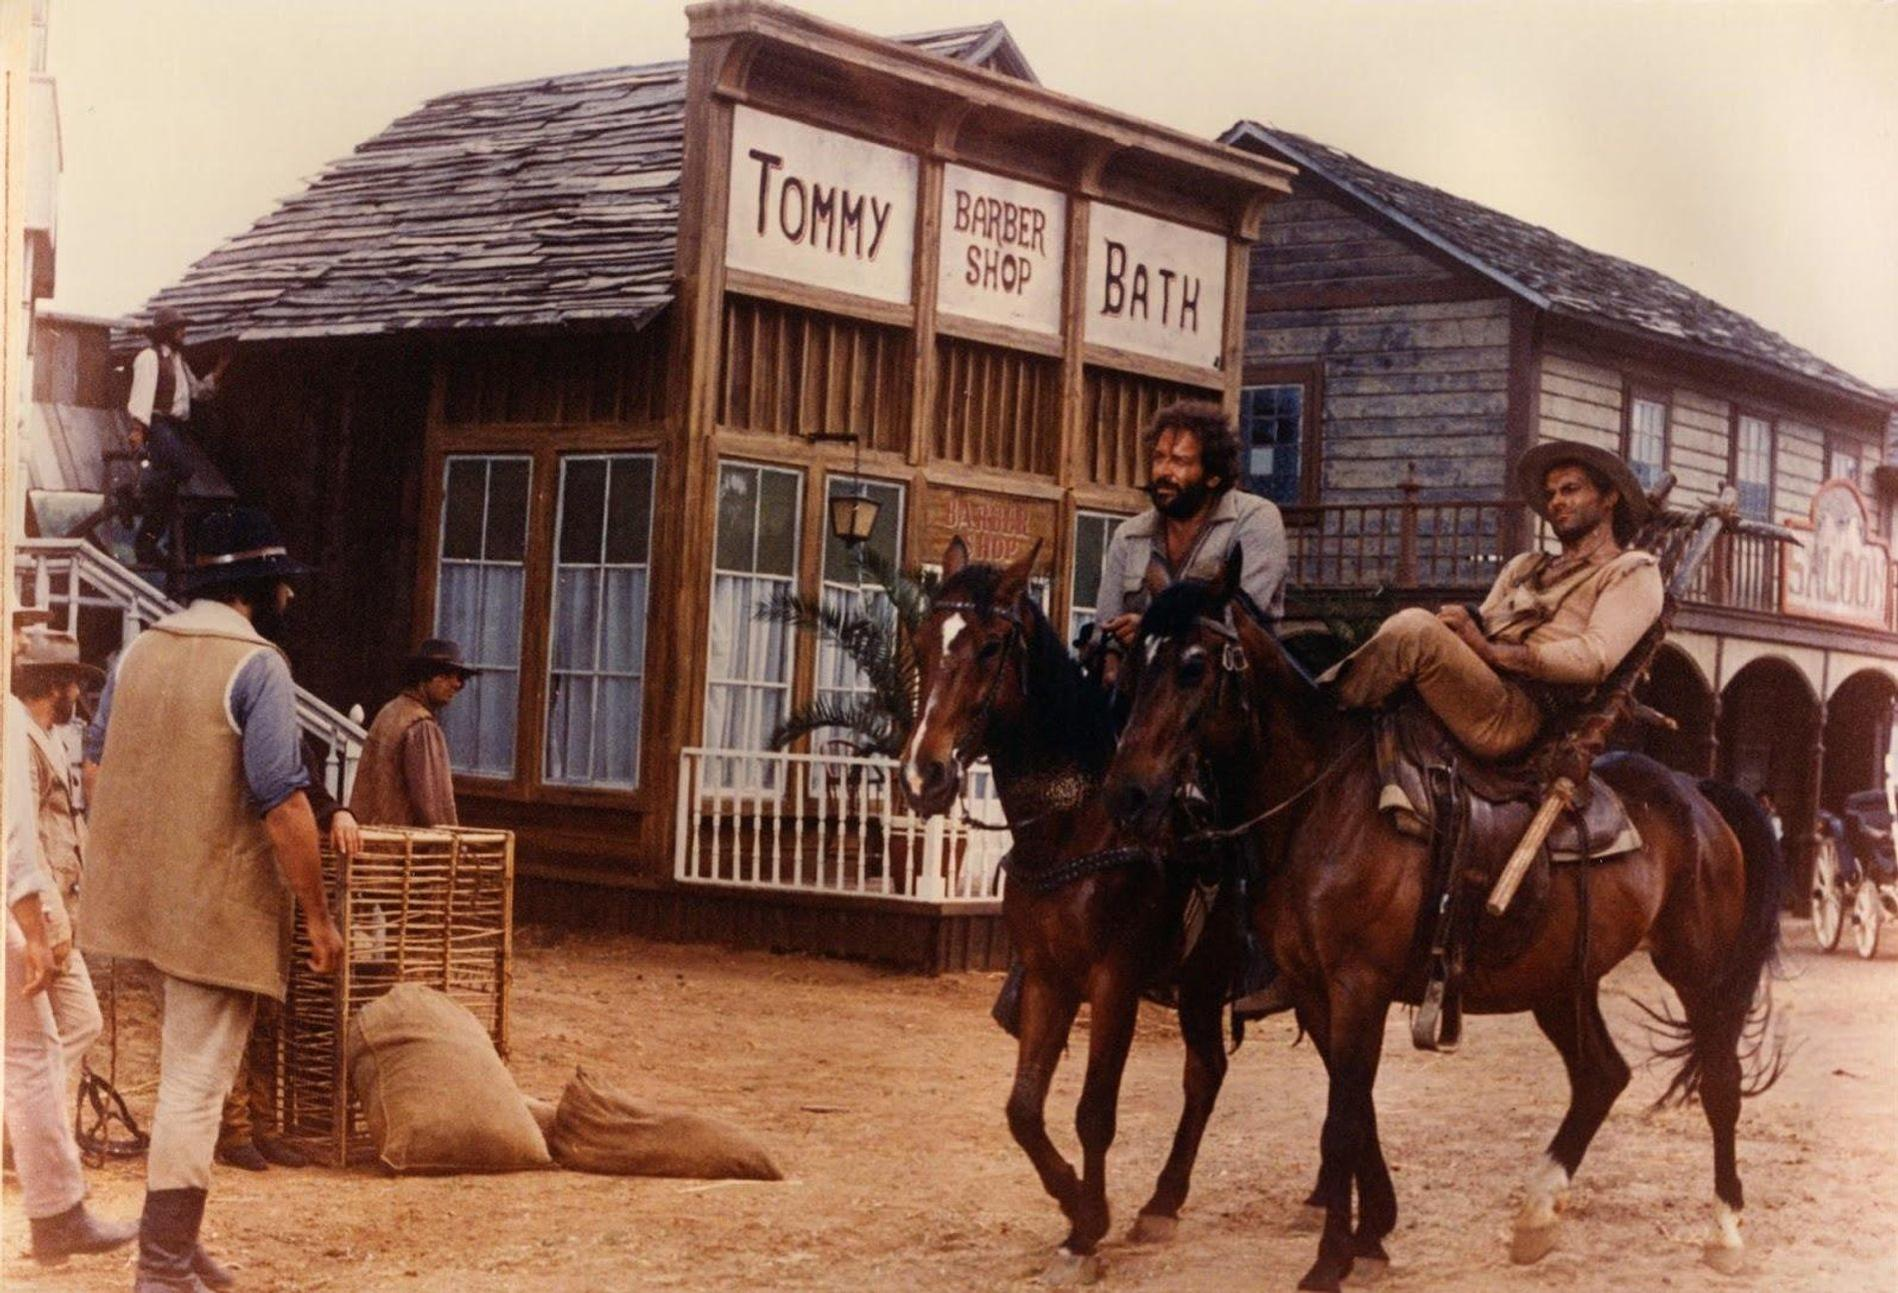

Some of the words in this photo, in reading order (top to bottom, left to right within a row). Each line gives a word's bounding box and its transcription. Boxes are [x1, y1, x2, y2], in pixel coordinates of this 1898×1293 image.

[748, 148, 893, 260] TOMMY
[953, 188, 1047, 257] BARBER
[965, 244, 1032, 296] SHOP
[1100, 237, 1201, 334] BATH
[964, 531, 1020, 564] SHOP
[1788, 544, 1884, 611] SALOON
